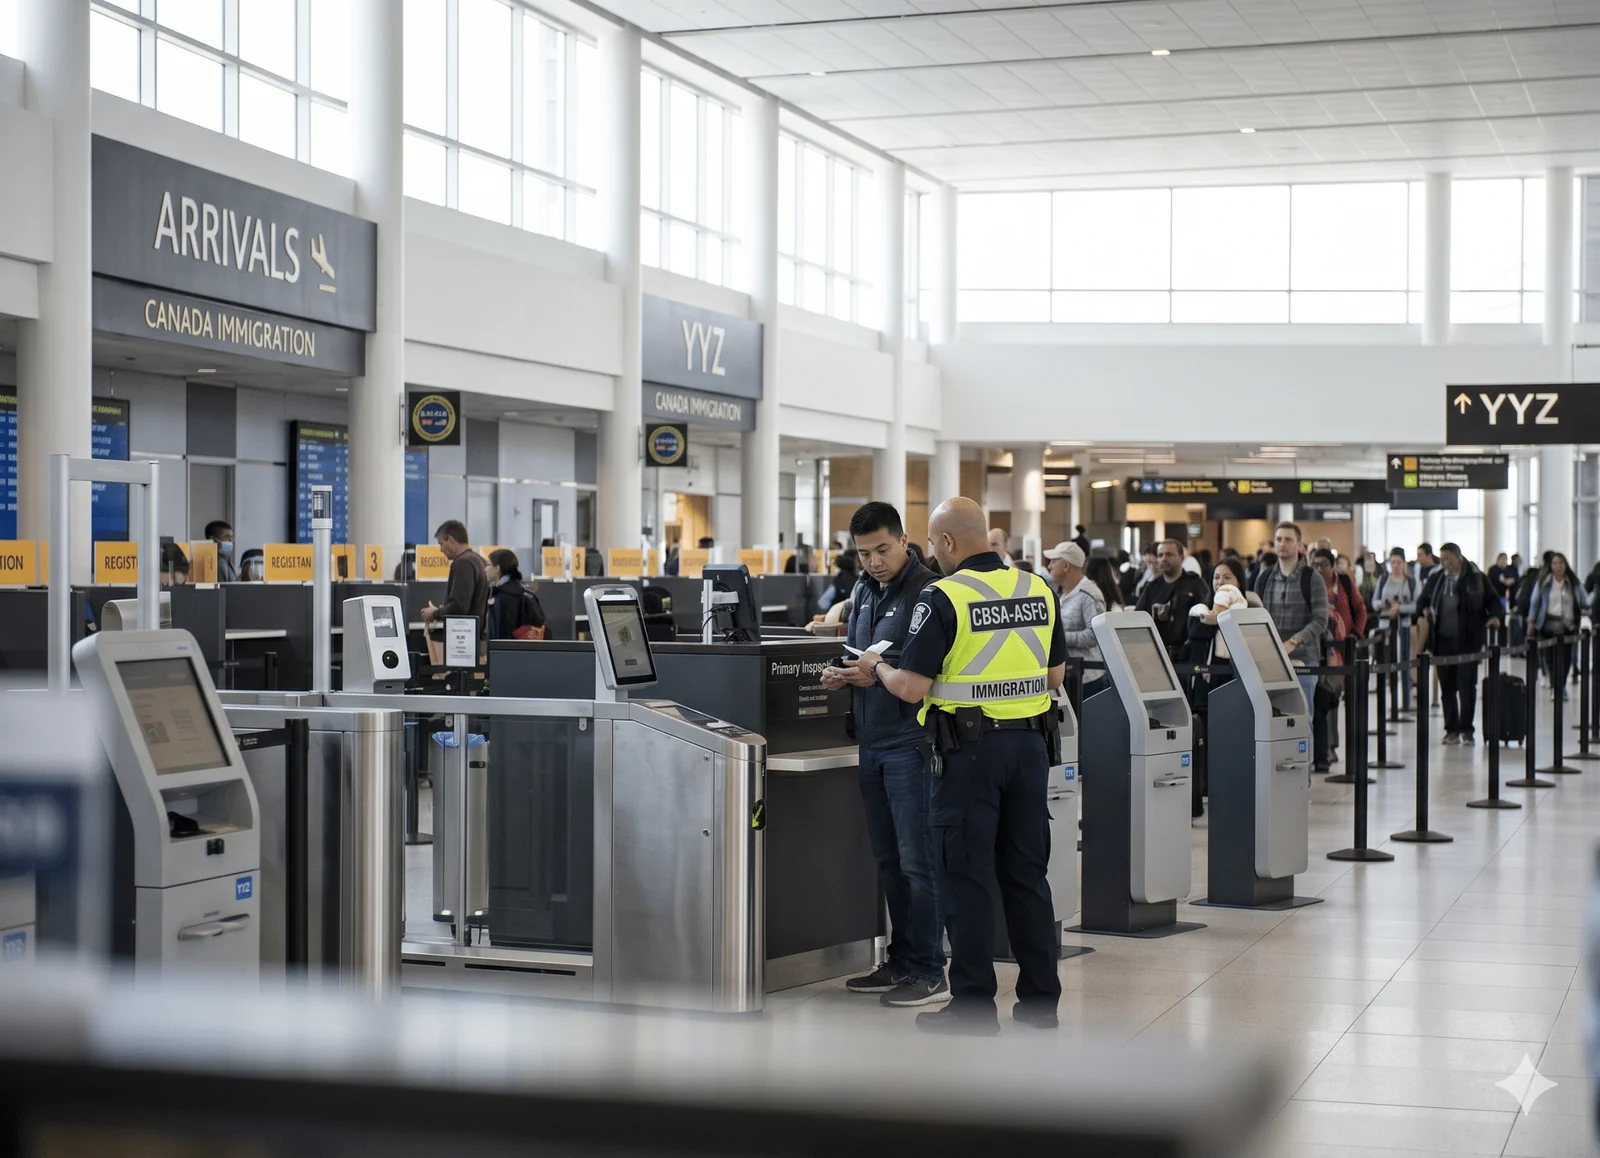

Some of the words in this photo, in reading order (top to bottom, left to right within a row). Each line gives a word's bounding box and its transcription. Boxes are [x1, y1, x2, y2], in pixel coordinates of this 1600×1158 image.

[153, 191, 301, 284] ARRIVALS
[144, 299, 214, 339] CANADA
[217, 312, 316, 358] IMMIGRATION
[681, 319, 726, 376] YYZ
[655, 391, 688, 414] CANADA
[1479, 392, 1559, 425] YYZ
[104, 555, 138, 570] REGIST
[370, 551, 378, 572] 3
[575, 552, 581, 571] 3
[972, 602, 1047, 627] CBSA-ASFC
[771, 662, 800, 677] Primary
[972, 677, 1046, 699] IMMIGRATION
